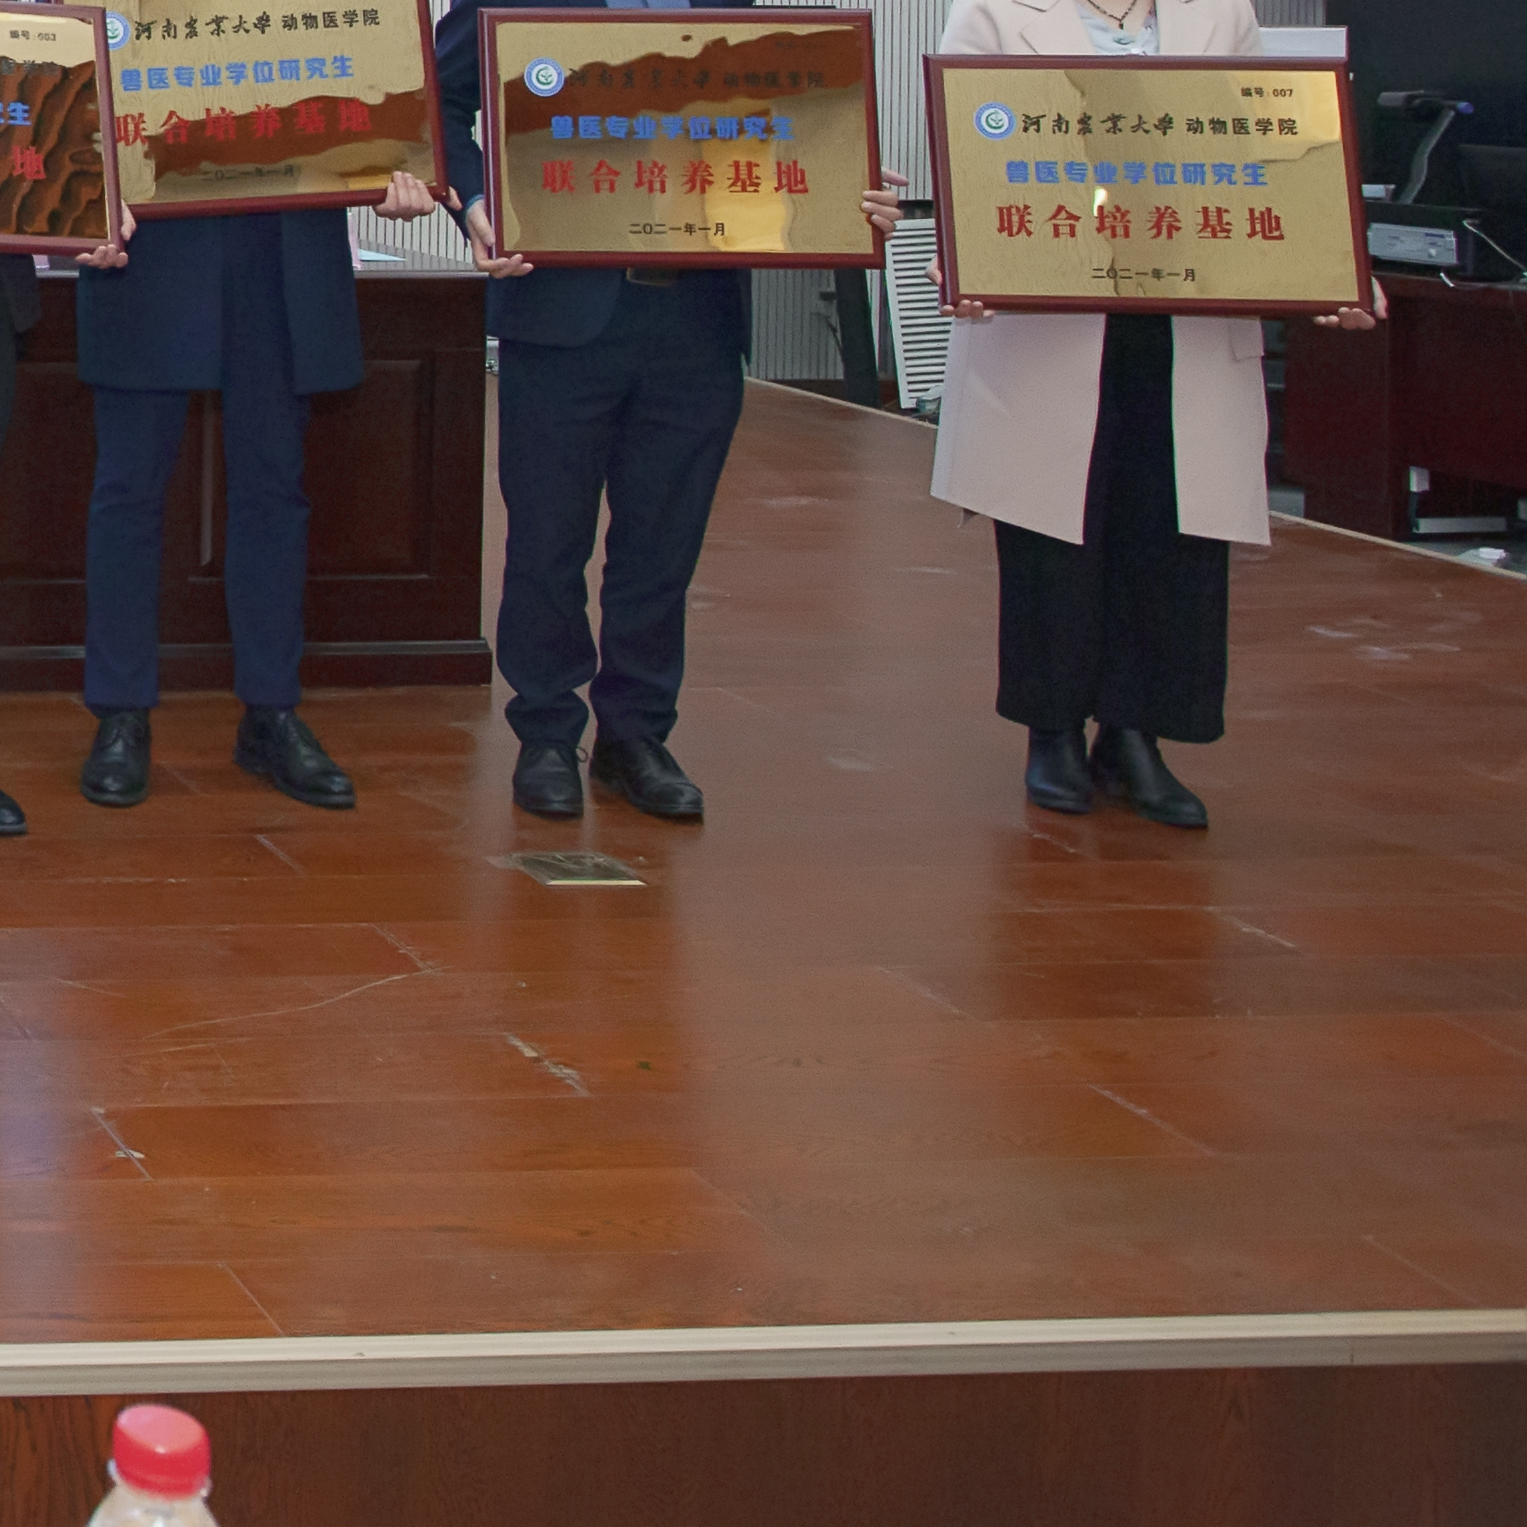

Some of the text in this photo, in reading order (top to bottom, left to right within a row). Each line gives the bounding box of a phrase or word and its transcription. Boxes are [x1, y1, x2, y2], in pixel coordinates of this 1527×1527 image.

[120, 55, 355, 93] 兽医专业学位研究生
[115, 98, 372, 147] 联合培养基地
[550, 114, 796, 141] 兽医专业学位研究生
[541, 159, 810, 196] 联合培养基地
[1005, 160, 1269, 187] 兽医专业学位研究生
[996, 203, 1286, 242] 联合培养基地
